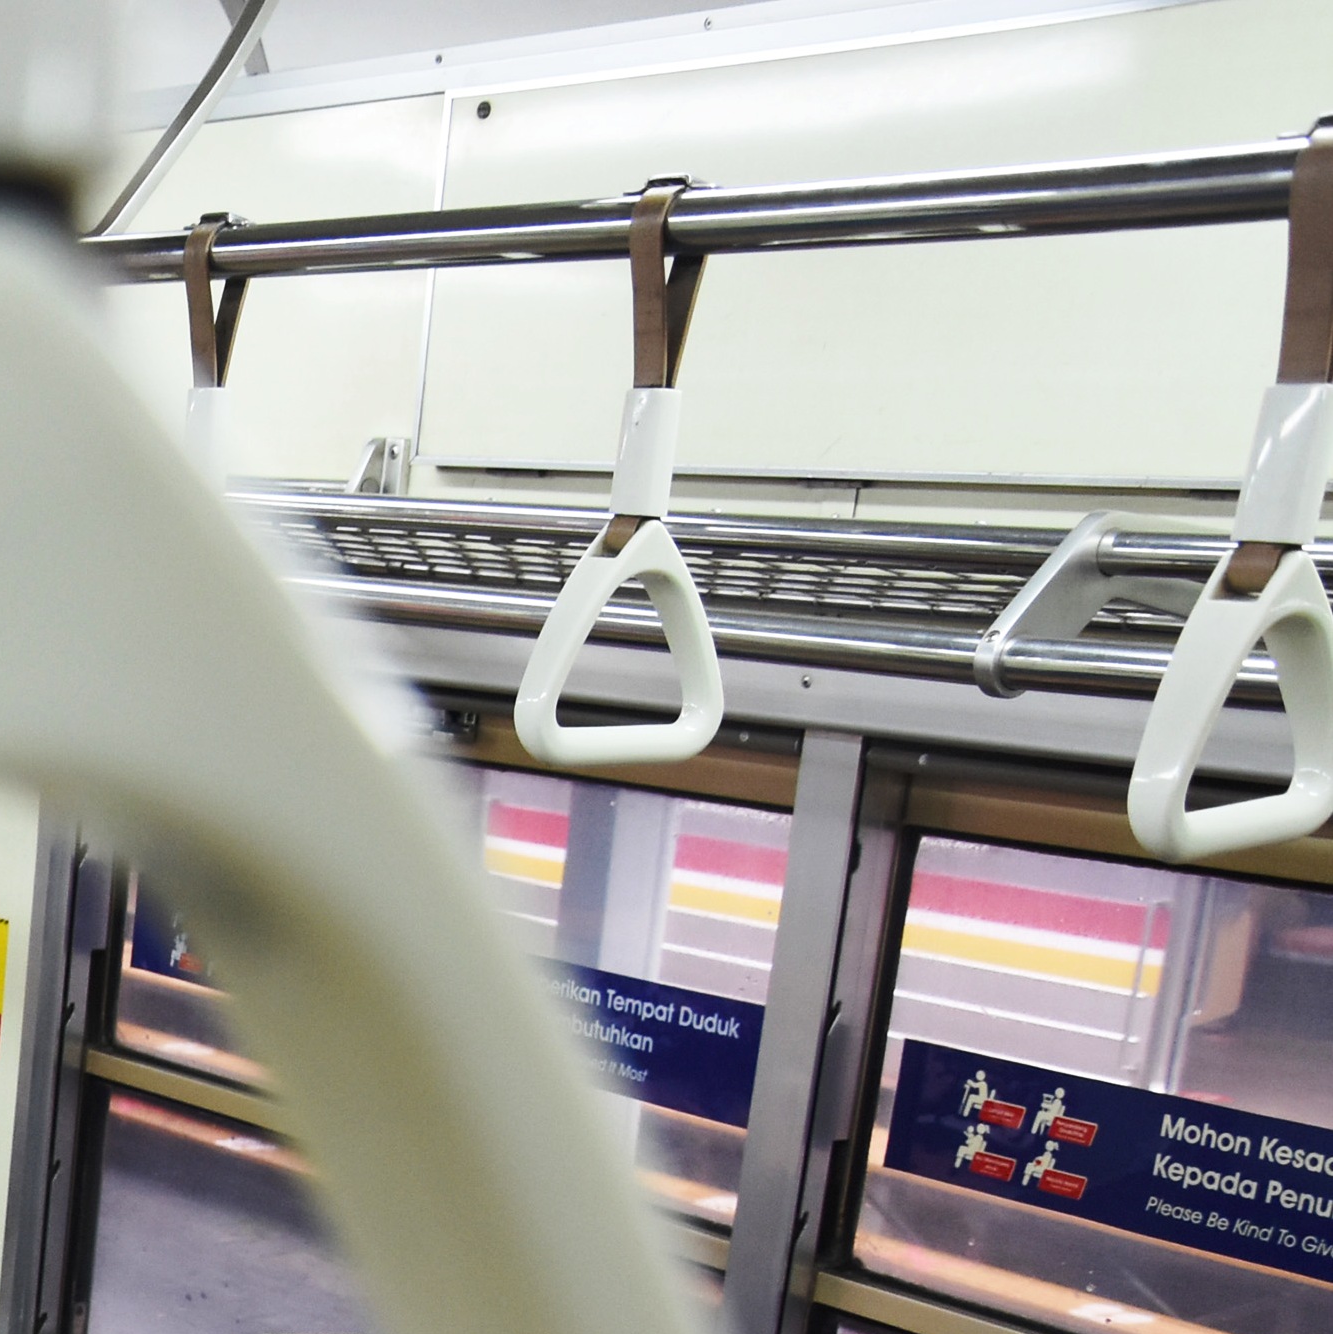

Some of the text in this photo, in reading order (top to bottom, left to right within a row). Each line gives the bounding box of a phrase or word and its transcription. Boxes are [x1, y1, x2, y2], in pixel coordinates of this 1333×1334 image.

[606, 988, 675, 1023] Tempat
[678, 1005, 740, 1039] Duduk
[617, 1063, 649, 1083] Most
[1159, 1113, 1252, 1157] Mohon
[1152, 1152, 1333, 1220] Kepada Penu
[1145, 1195, 1203, 1225] Please
[1206, 1211, 1230, 1232] Be
[1232, 1218, 1274, 1242] Kind
[1277, 1228, 1297, 1248] To
